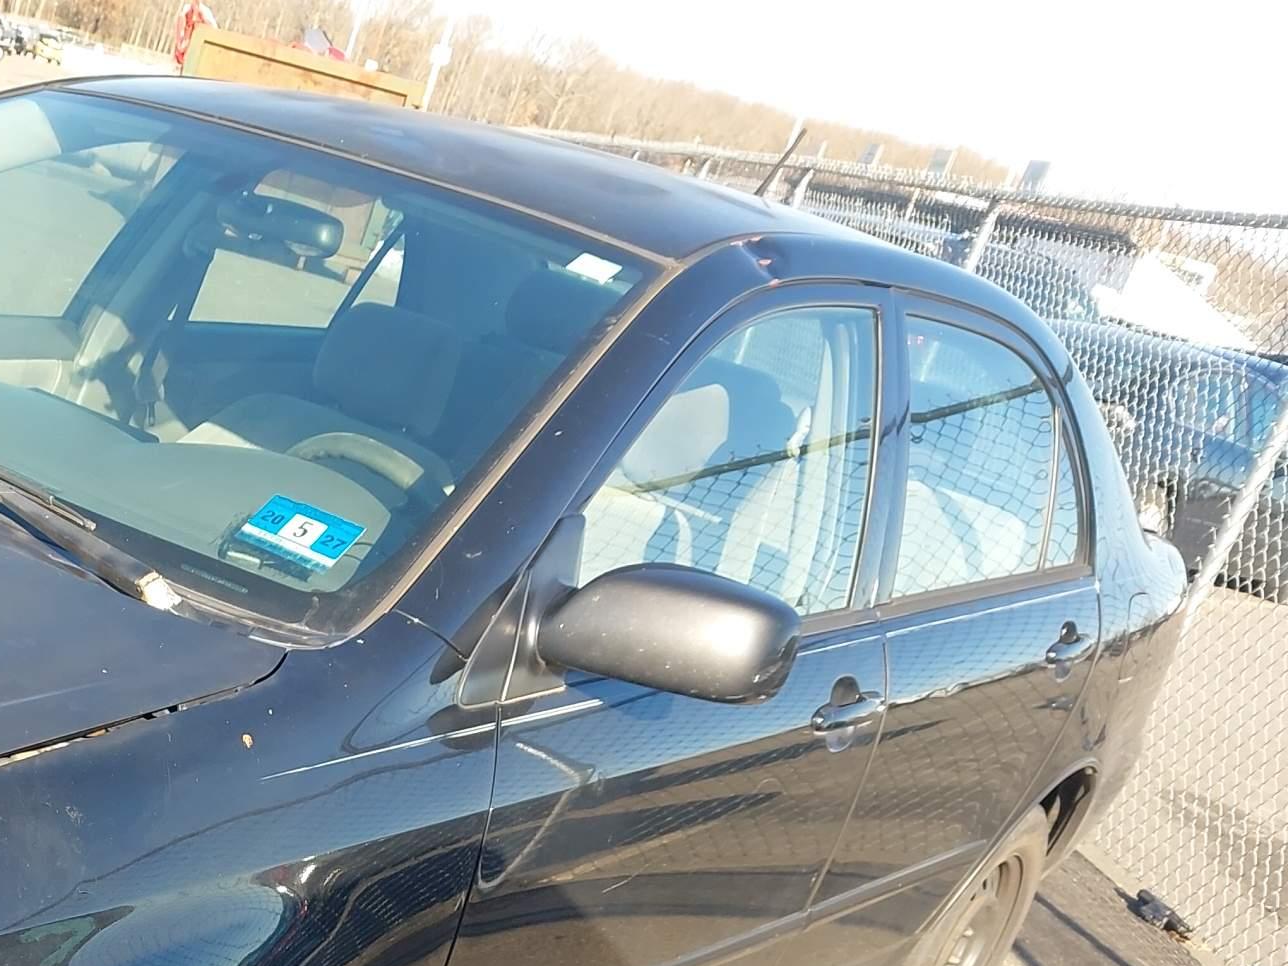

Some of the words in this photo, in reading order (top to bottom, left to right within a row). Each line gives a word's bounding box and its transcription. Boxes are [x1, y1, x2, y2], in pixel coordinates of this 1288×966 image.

[261, 510, 285, 525] 20
[292, 521, 314, 538] 5
[321, 534, 347, 550] 27
